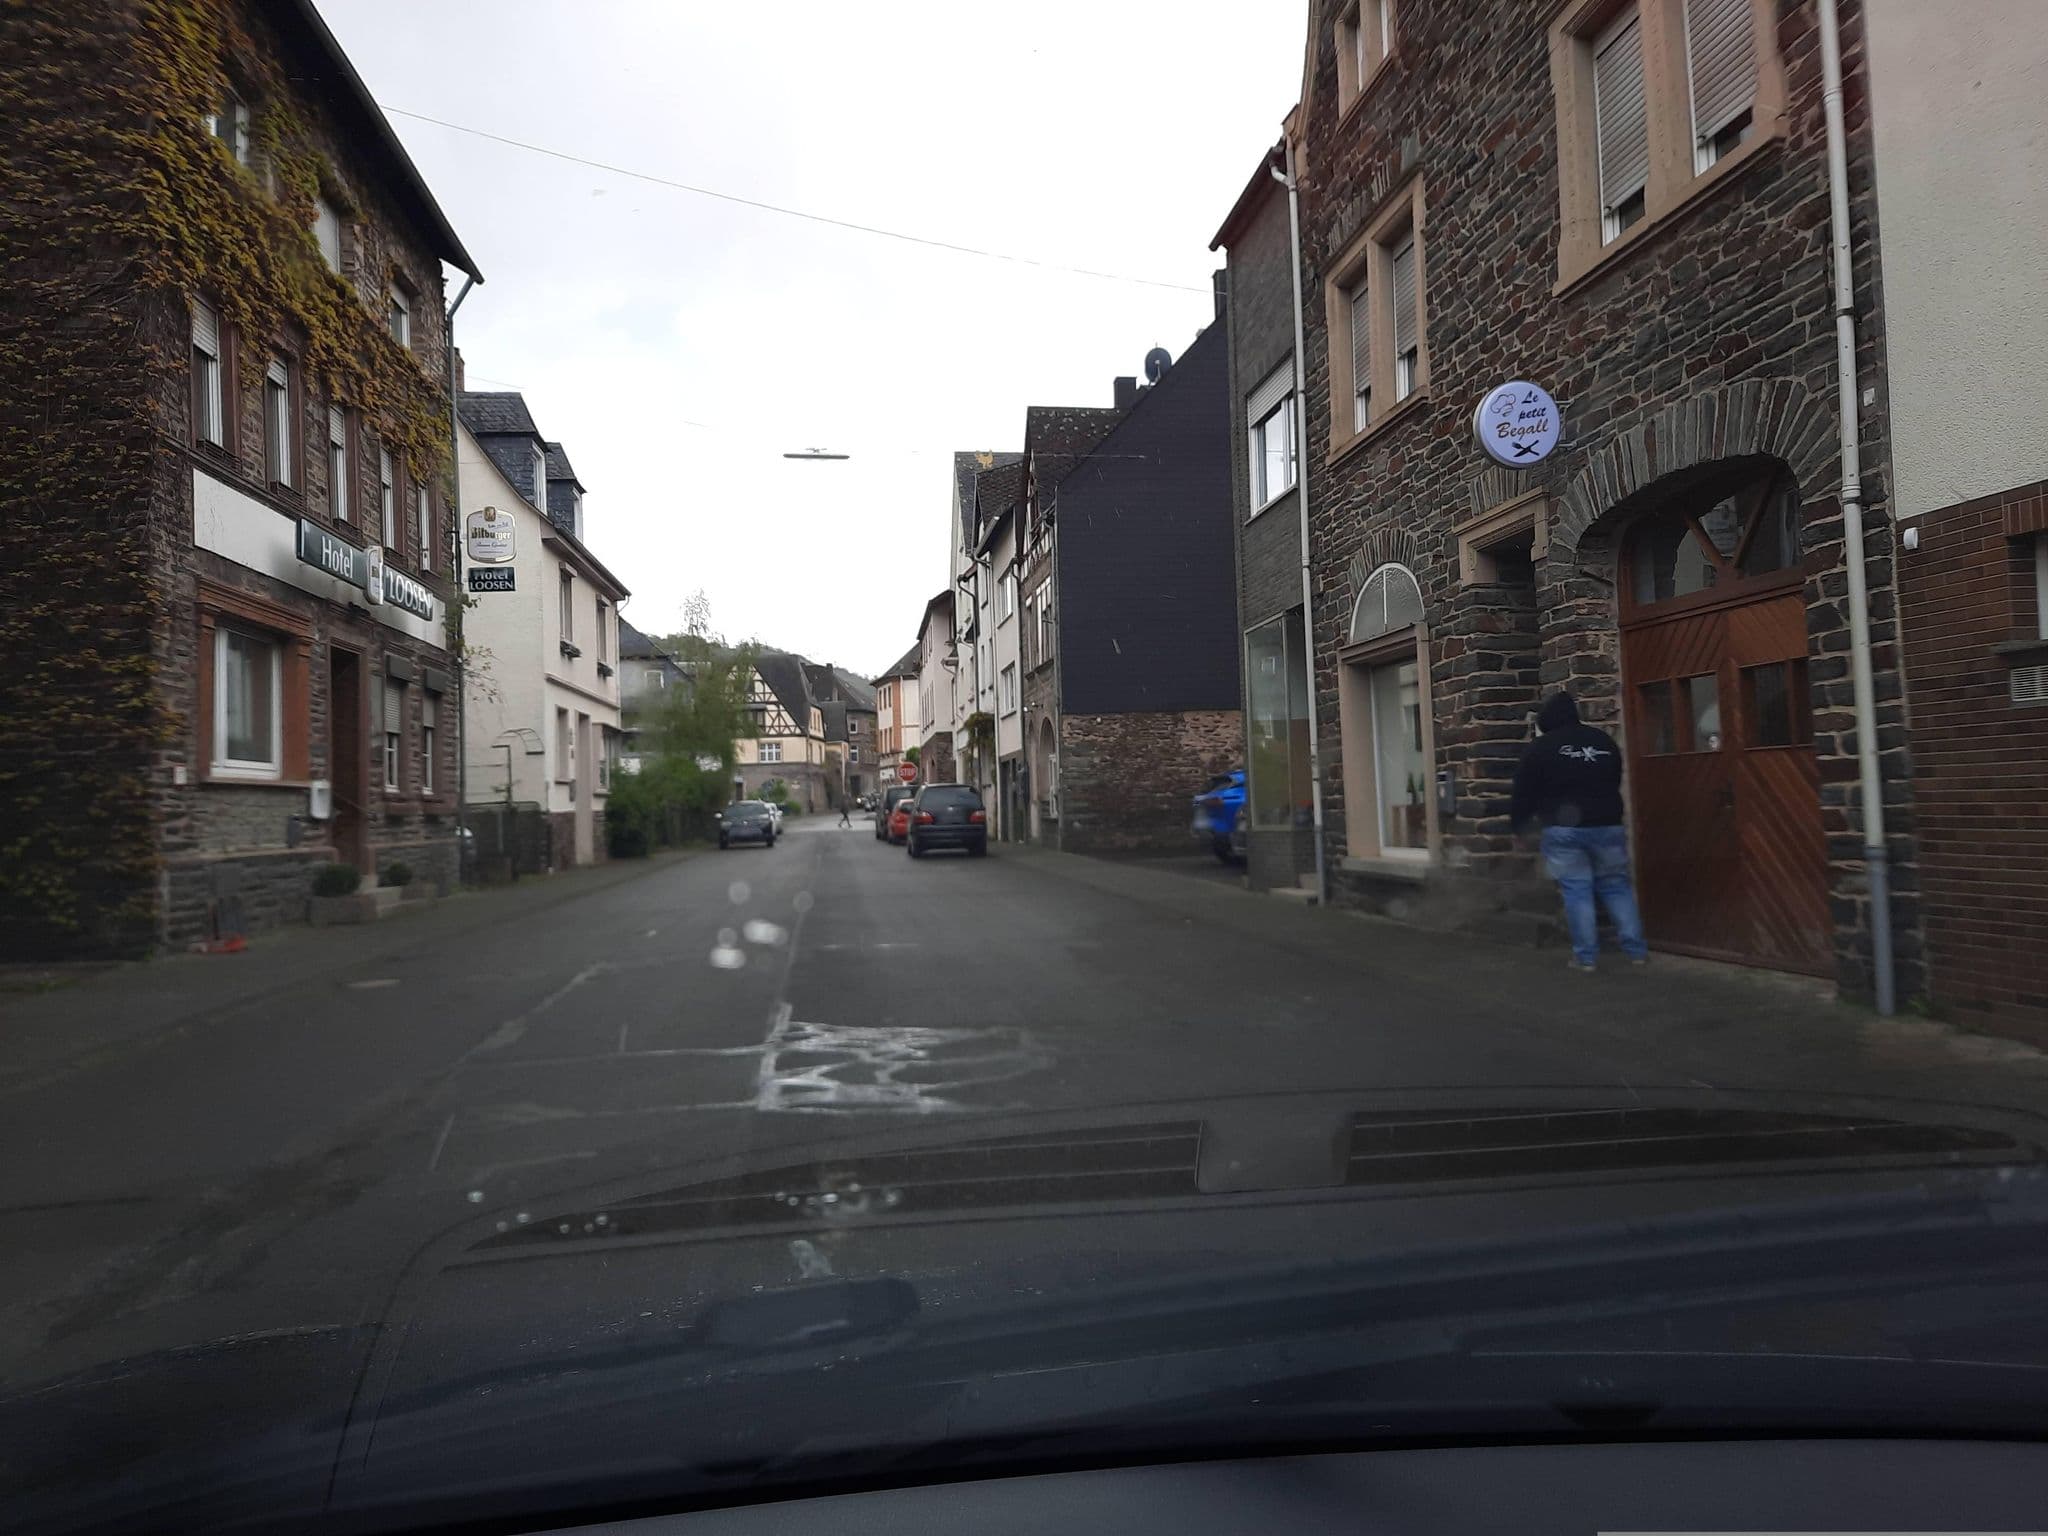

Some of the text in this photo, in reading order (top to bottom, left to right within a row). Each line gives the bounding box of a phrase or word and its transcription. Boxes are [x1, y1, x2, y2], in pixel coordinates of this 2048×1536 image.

[1521, 390, 1539, 404] Le
[1518, 407, 1547, 423] petit
[1496, 418, 1549, 441] Begall
[471, 526, 512, 541] Bitburger
[321, 535, 354, 579] Hotel
[470, 580, 514, 591] LOOSEN
[899, 768, 916, 777] STOP
